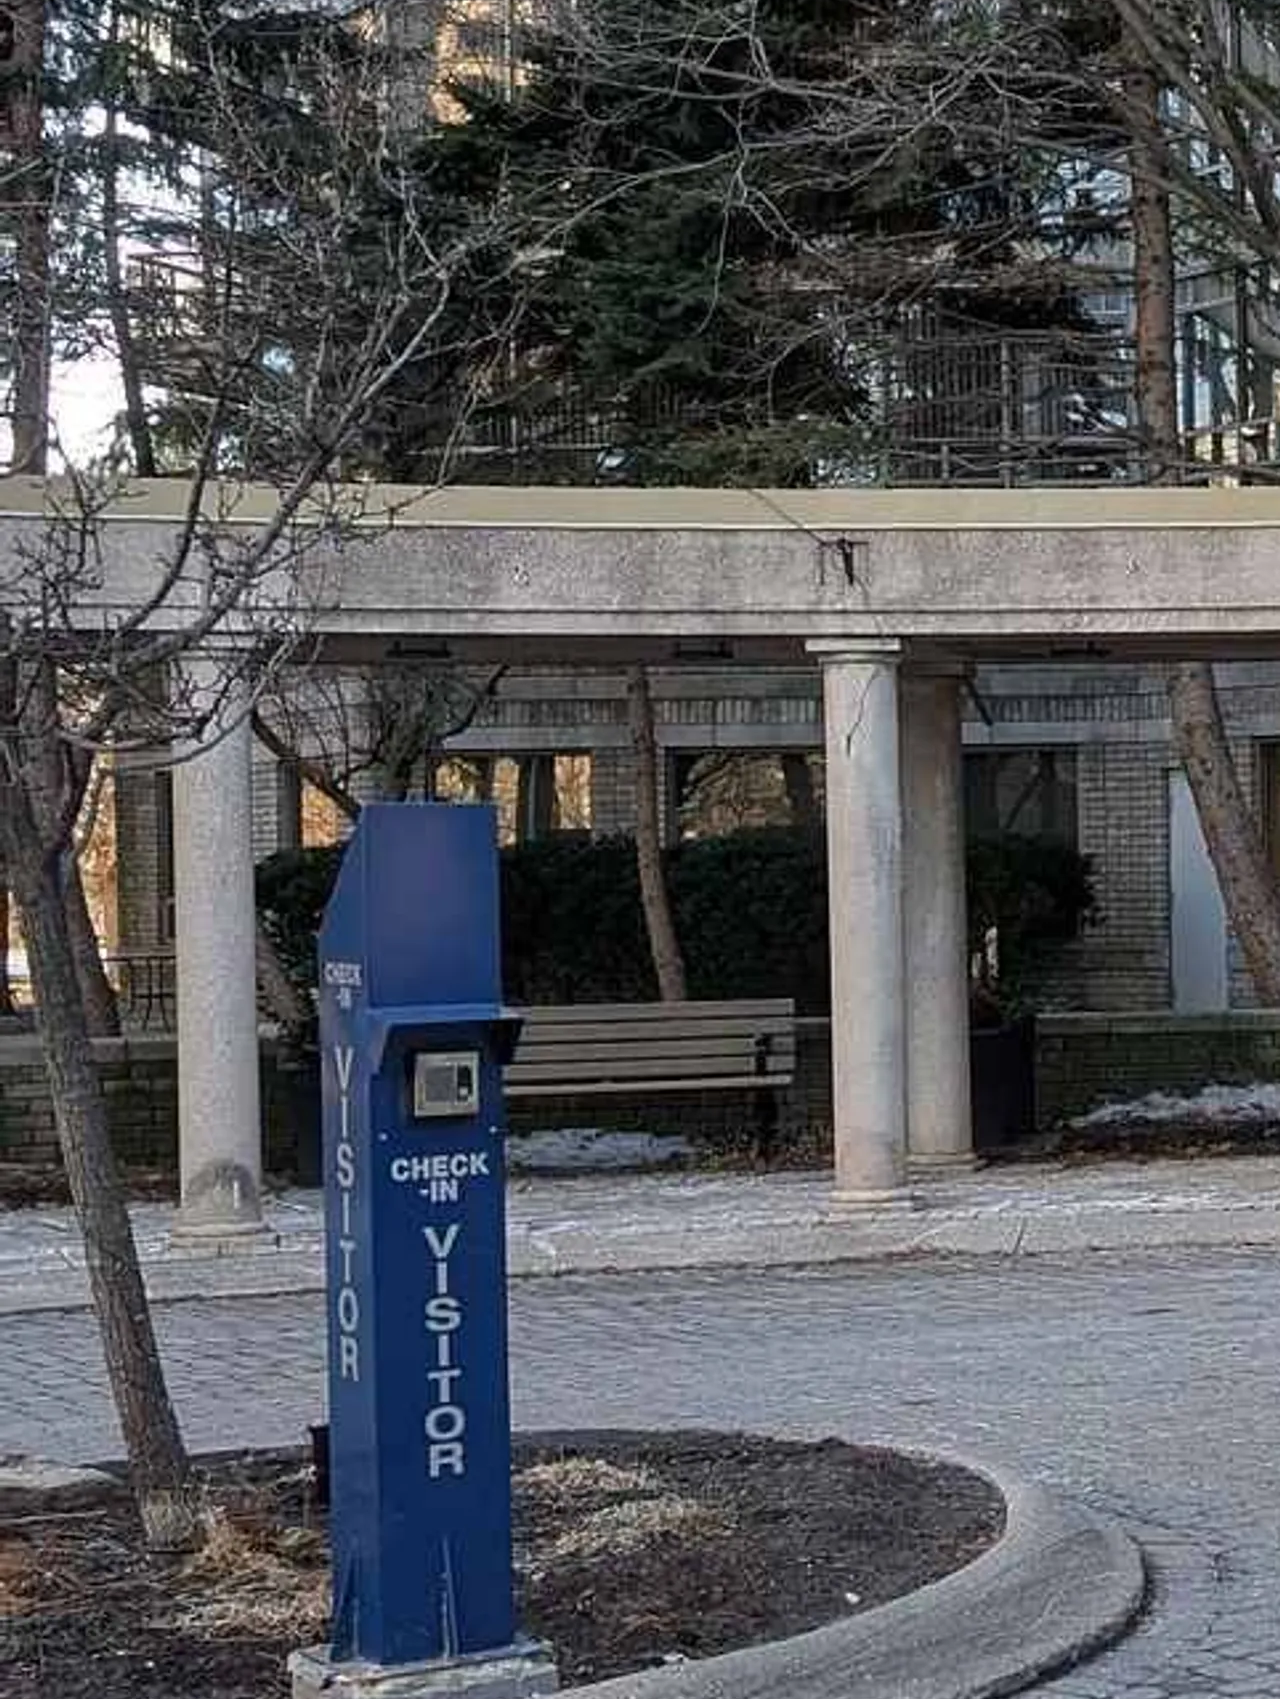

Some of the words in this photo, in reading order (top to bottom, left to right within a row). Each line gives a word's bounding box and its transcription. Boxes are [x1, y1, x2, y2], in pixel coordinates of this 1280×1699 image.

[324, 962, 362, 987] CHECK
[391, 1153, 490, 1182] CHECK
[420, 1179, 459, 1203] -IN
[334, 1046, 359, 1381] VISITOR
[423, 1224, 467, 1478] VISITOR
